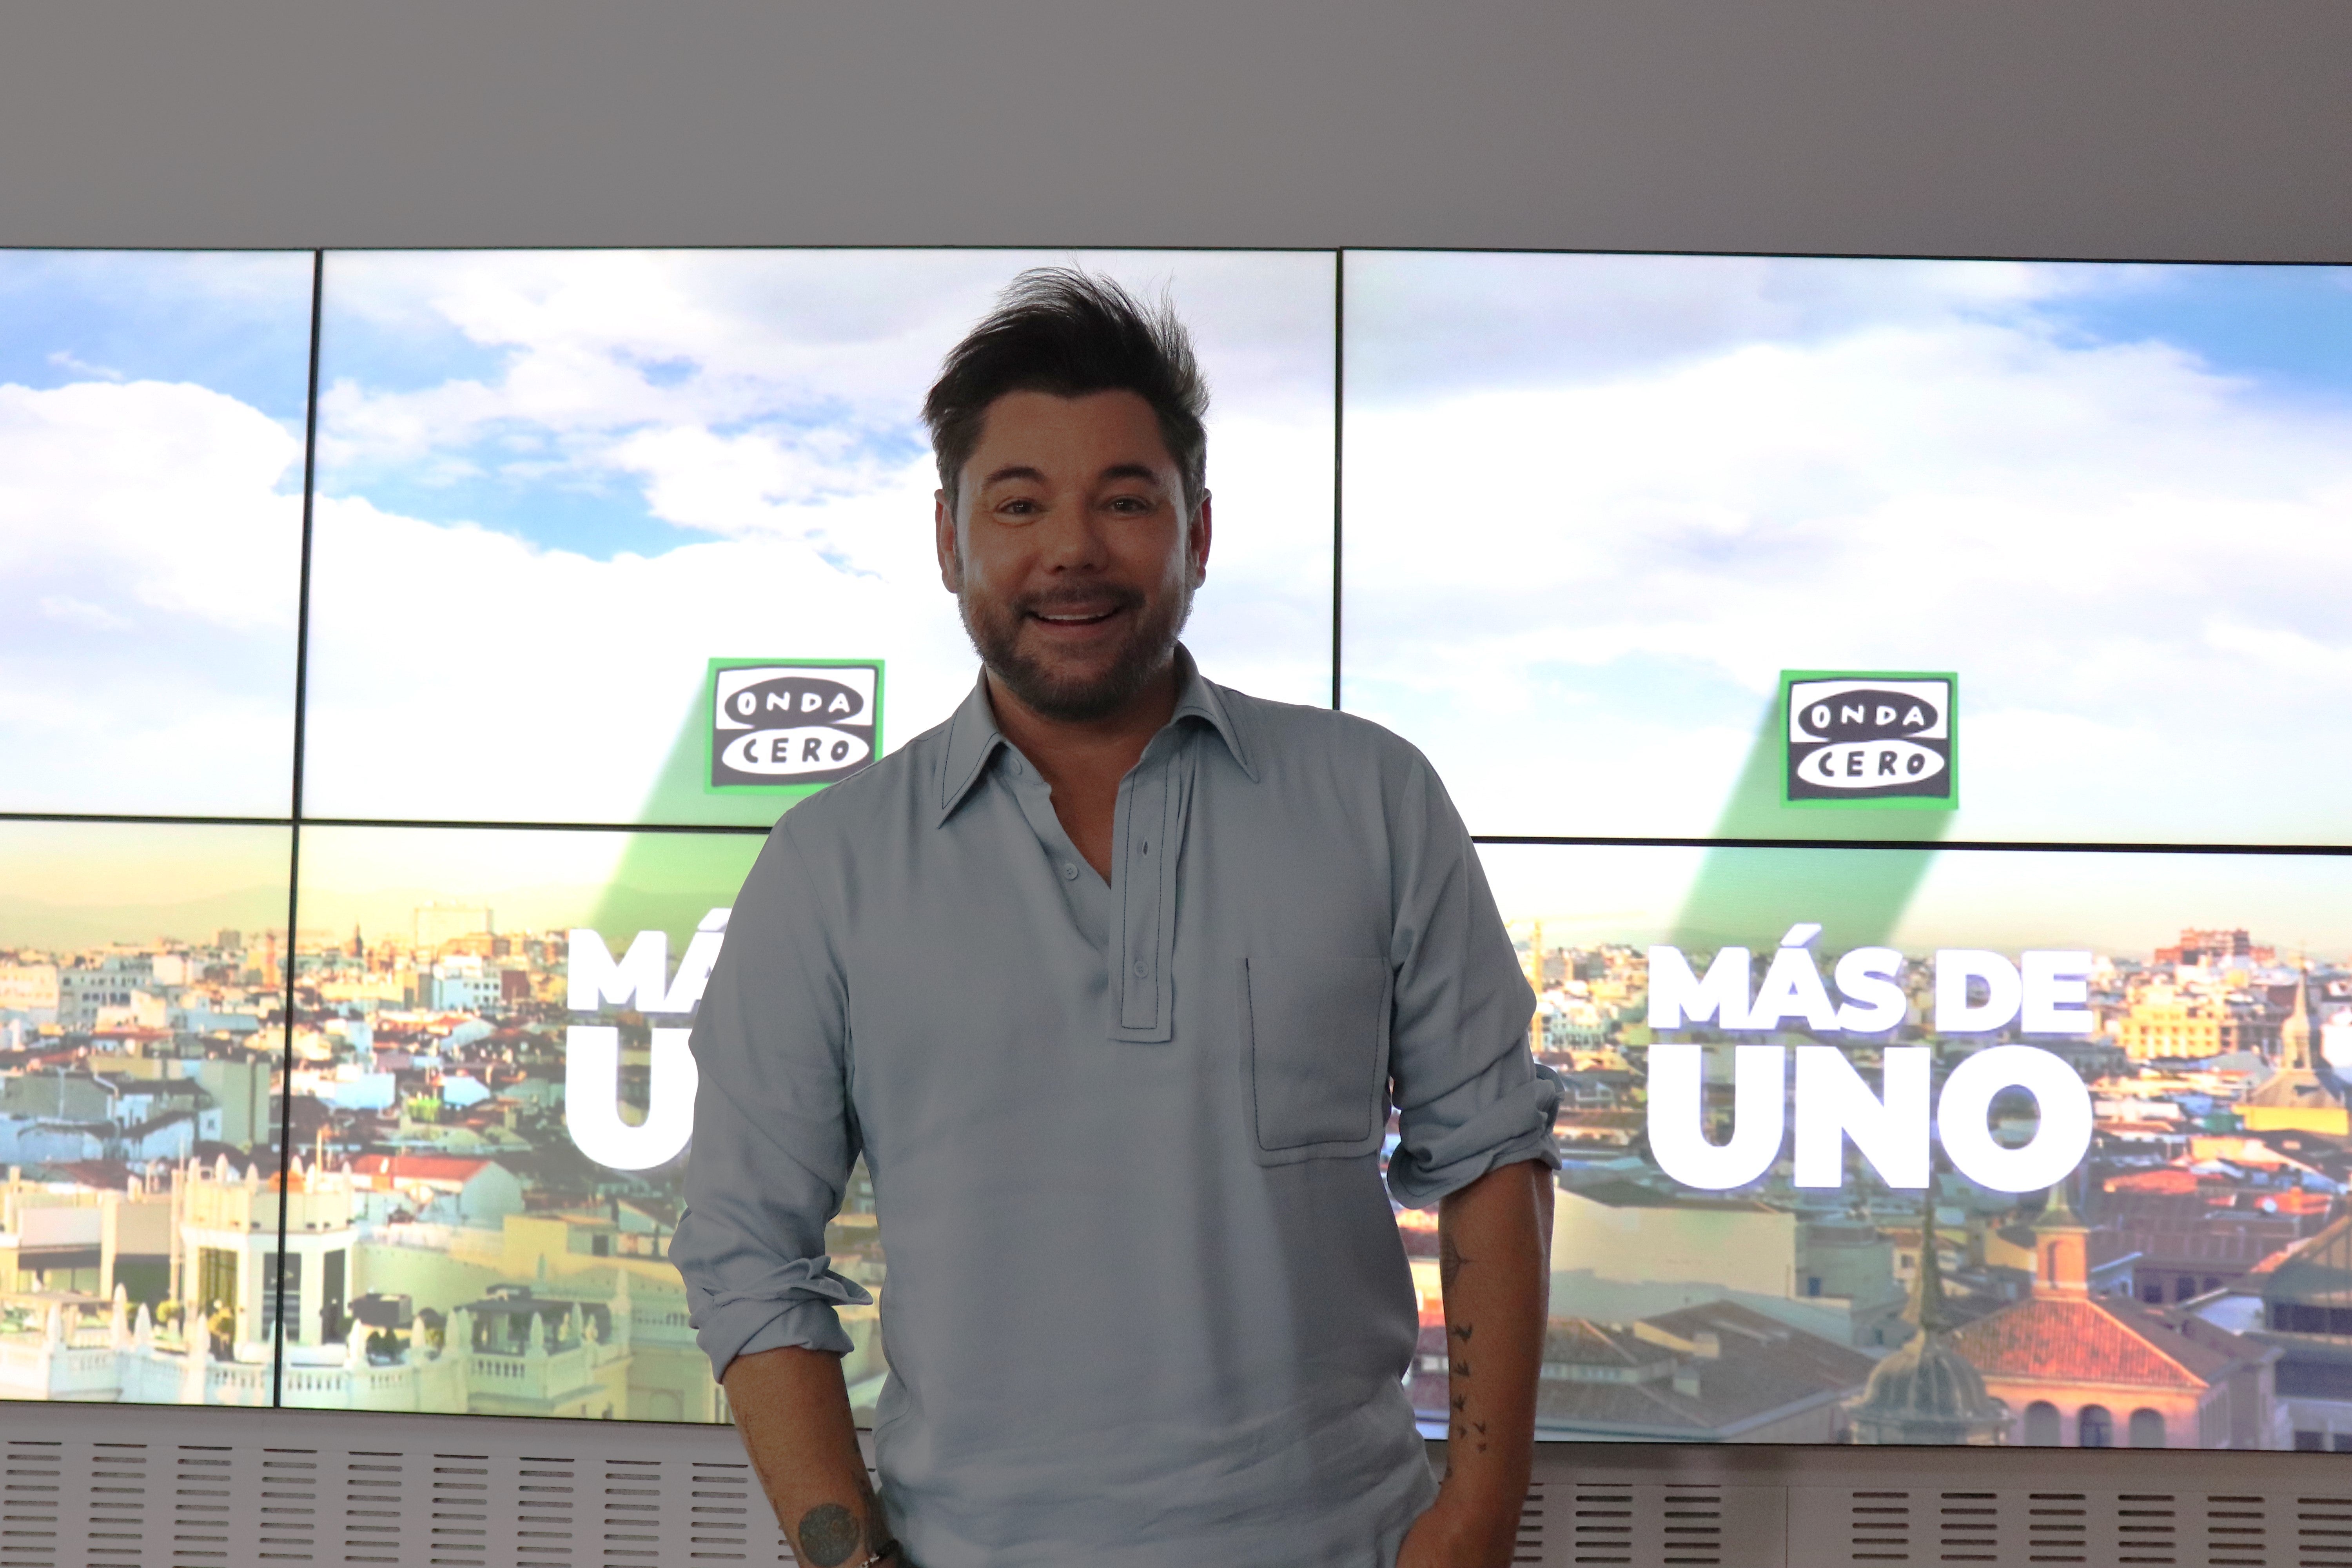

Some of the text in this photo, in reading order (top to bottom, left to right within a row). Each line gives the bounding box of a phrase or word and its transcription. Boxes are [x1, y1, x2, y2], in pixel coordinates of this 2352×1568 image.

[737, 691, 851, 715] ONDA
[1811, 704, 1924, 728] ONDA
[743, 738, 849, 763] CERO
[1818, 751, 1926, 777] CERO
[1648, 923, 2093, 1032] MÁS DE
[1648, 1044, 2093, 1192] UNO
